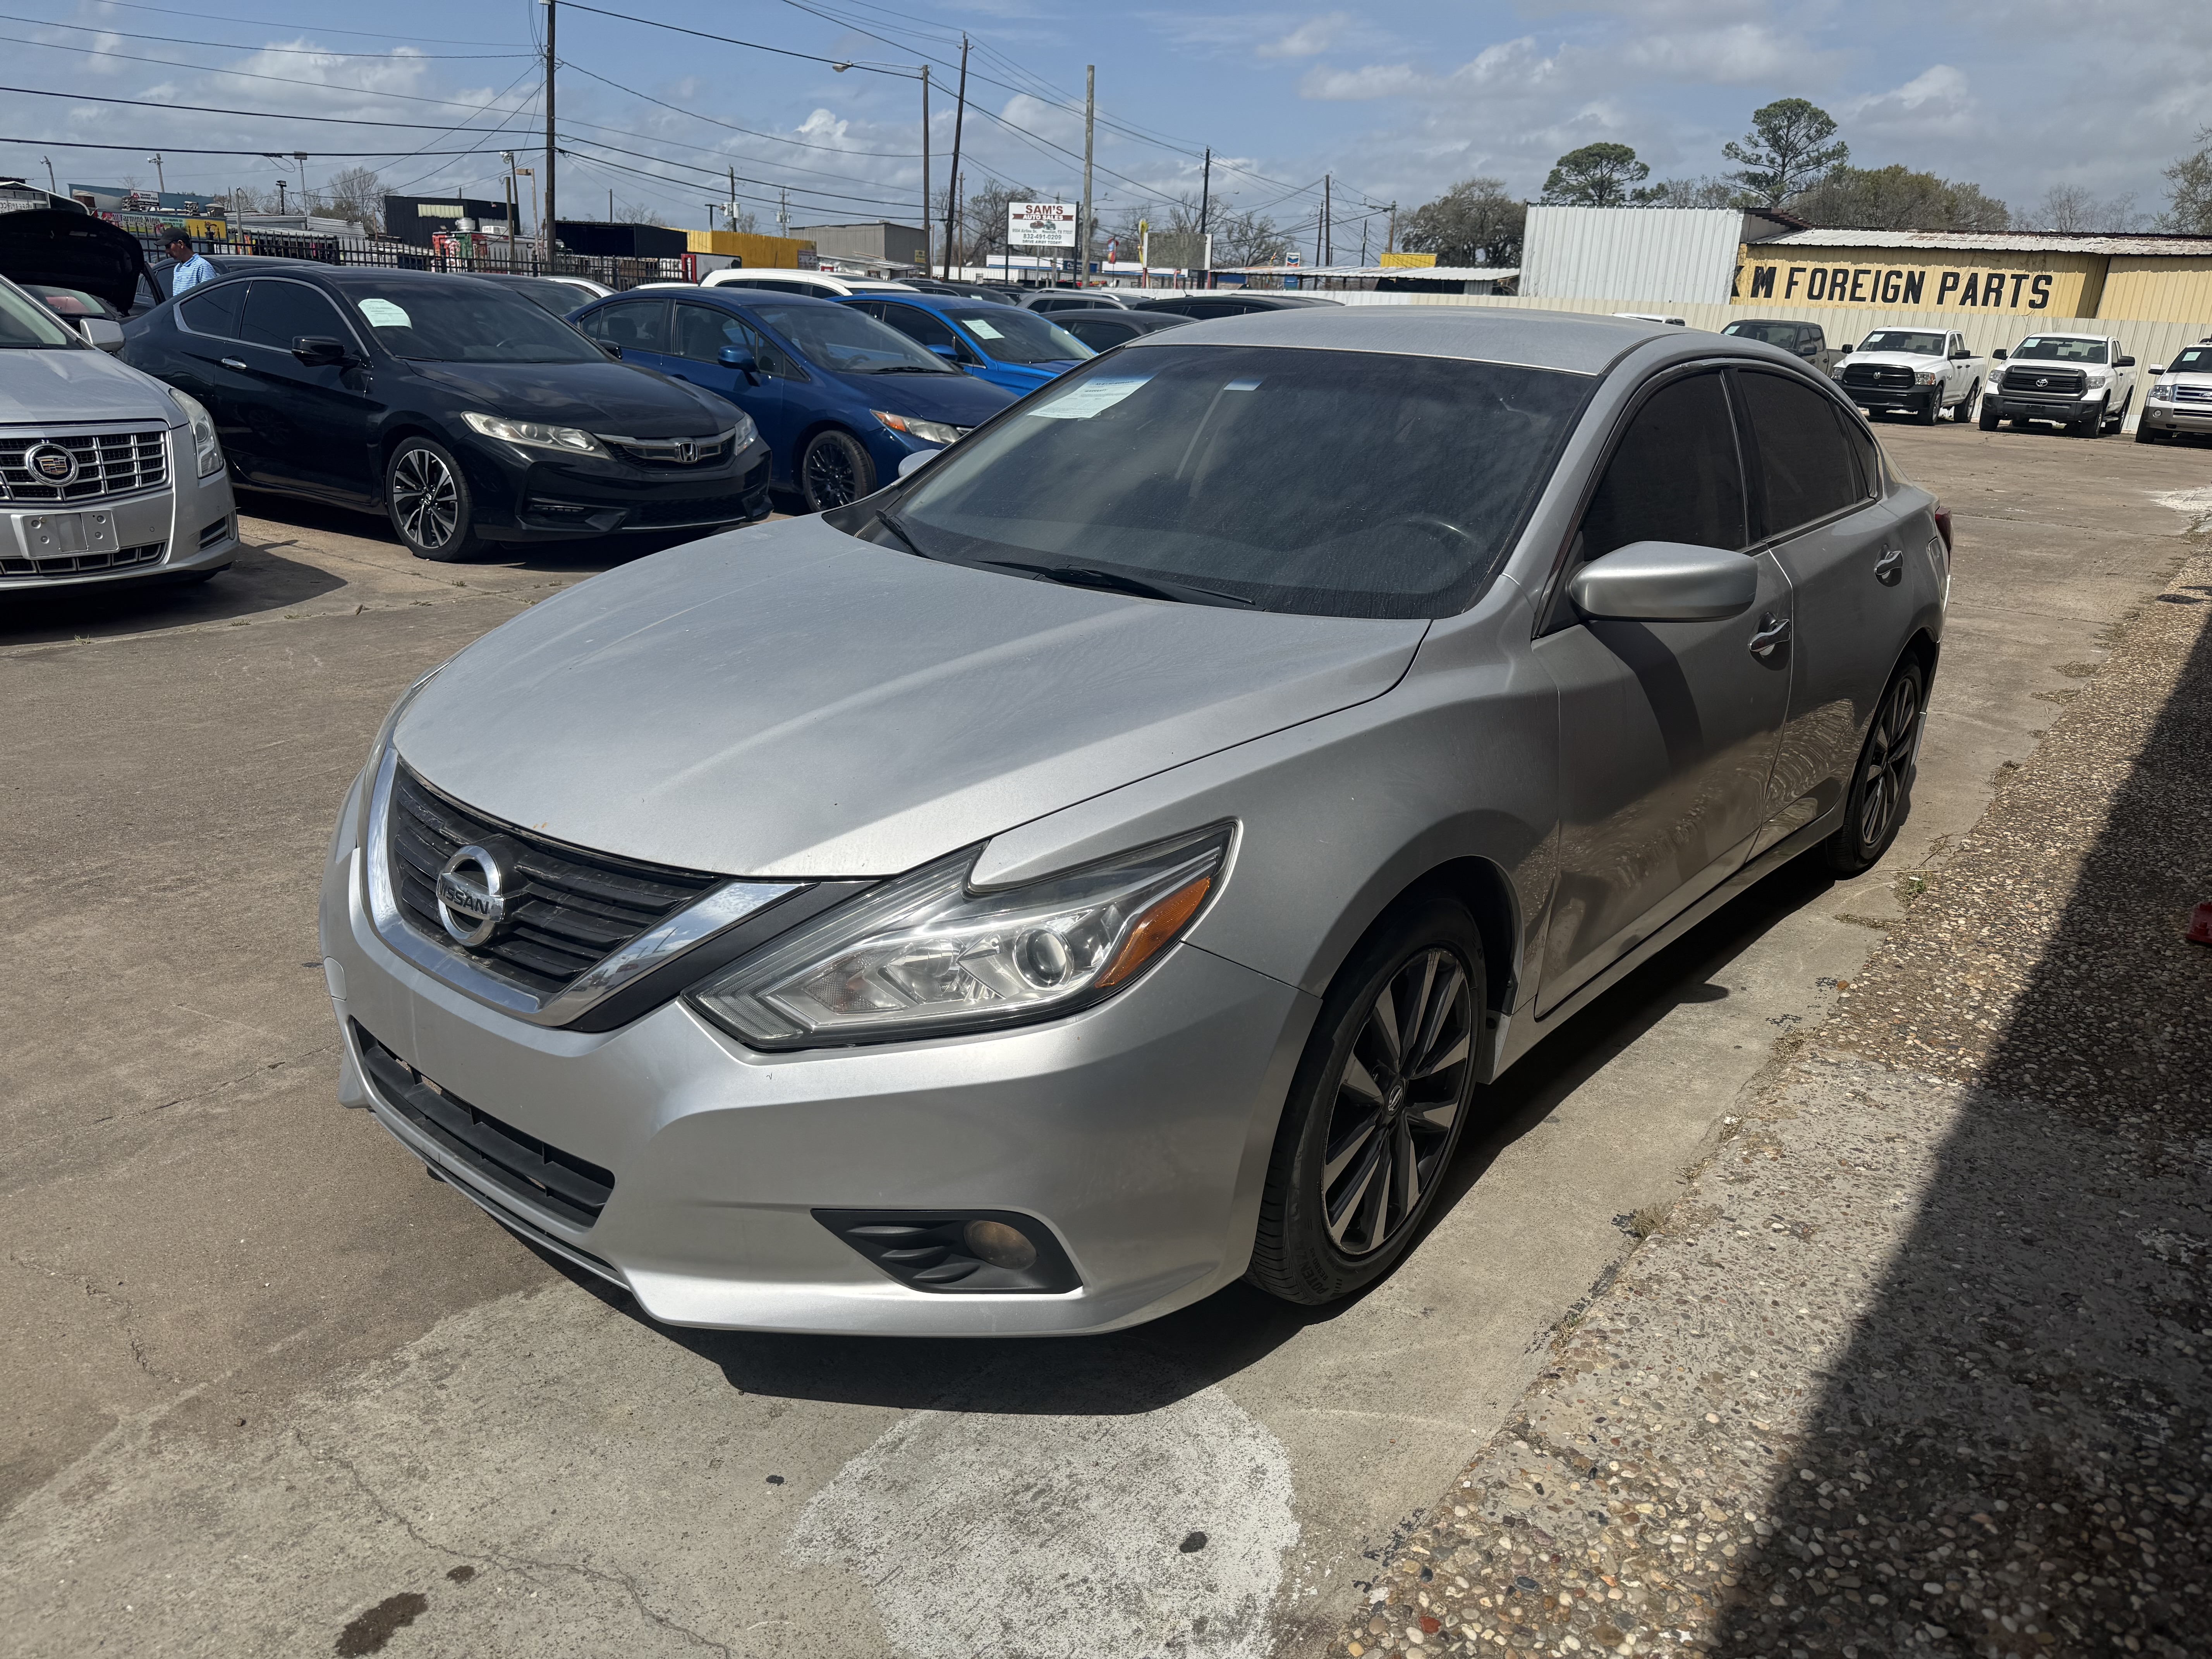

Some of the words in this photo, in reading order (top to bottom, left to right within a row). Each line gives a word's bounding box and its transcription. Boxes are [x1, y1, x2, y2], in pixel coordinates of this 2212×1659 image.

[1025, 205, 1063, 215] SAM'S
[1784, 267, 1926, 304] FOREIGN
[1937, 271, 2053, 309] PARTS
[437, 878, 489, 915] NISSAN
